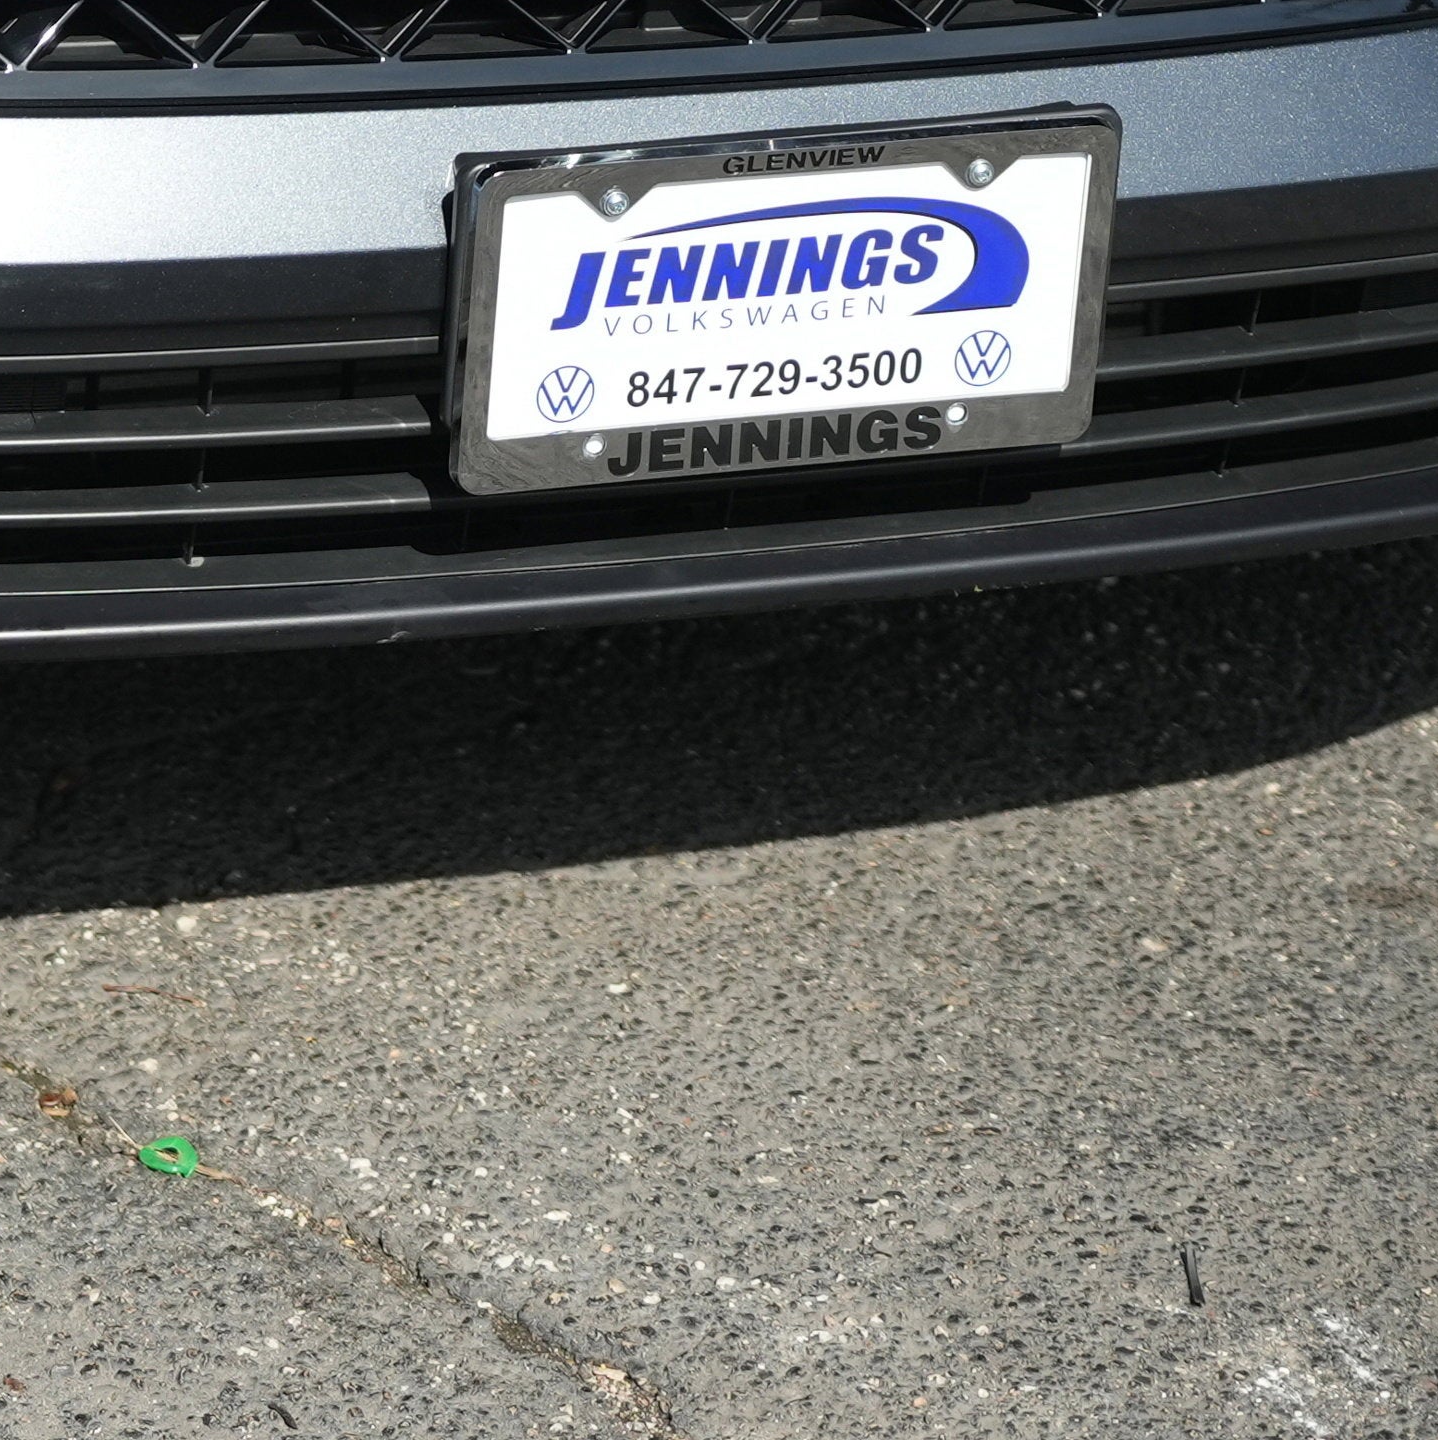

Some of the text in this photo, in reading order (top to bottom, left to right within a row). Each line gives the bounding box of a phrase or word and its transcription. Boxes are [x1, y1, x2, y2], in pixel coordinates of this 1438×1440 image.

[722, 144, 886, 177] GLENVIEW
[550, 223, 945, 331] JENNINGS
[604, 294, 887, 337] VOLKSWAGEN
[626, 346, 923, 408] 847-729-3500
[607, 405, 943, 478] JENNINGS
